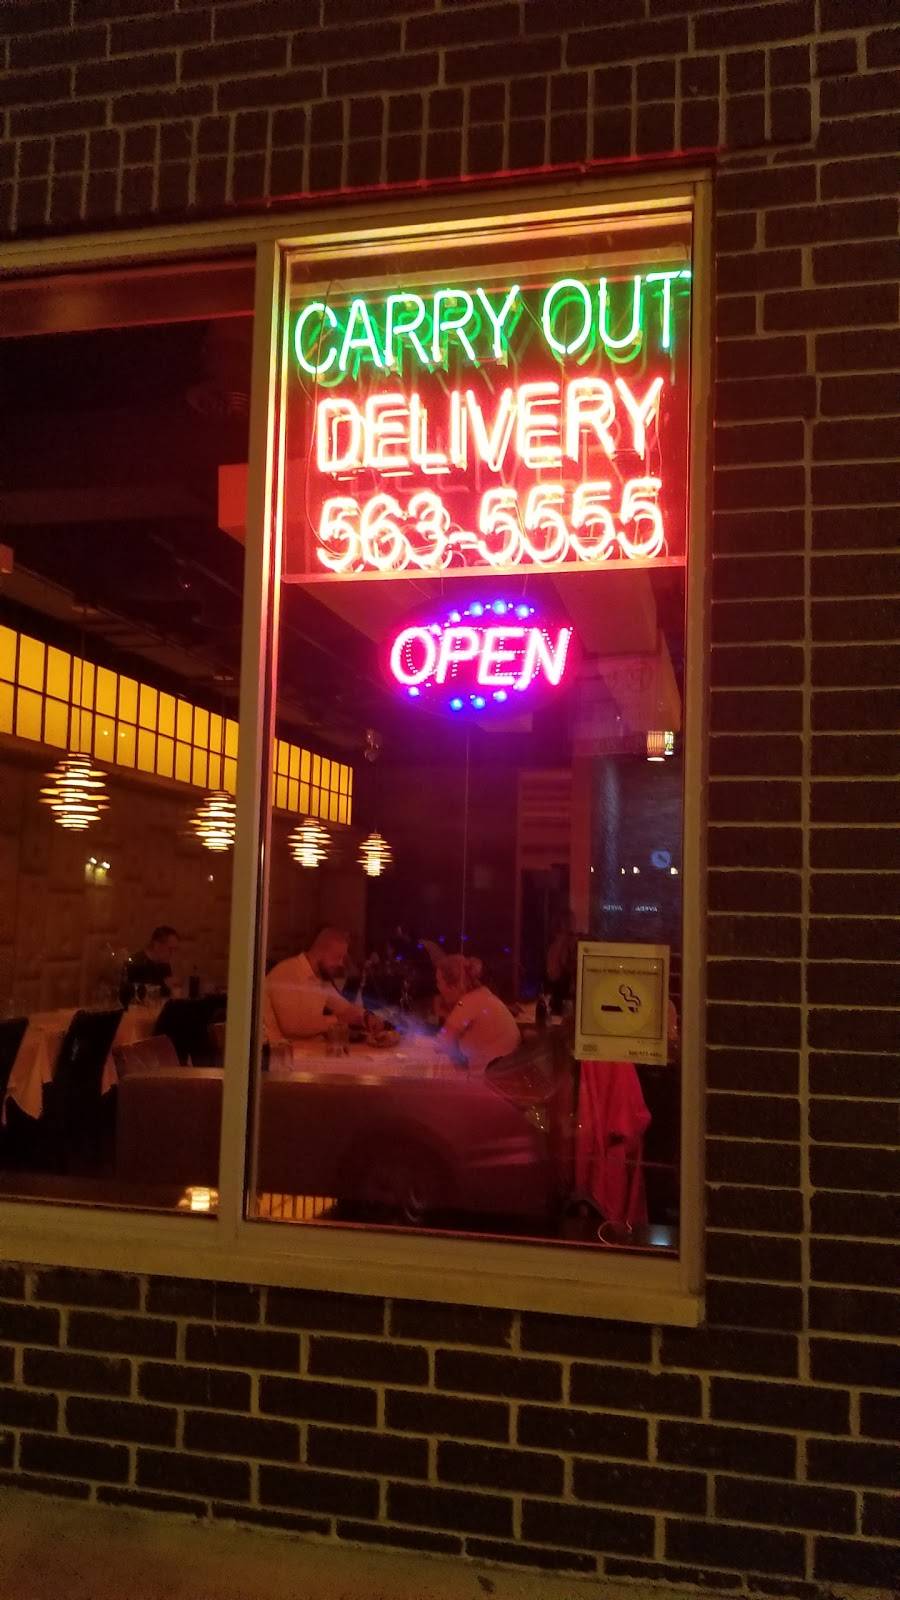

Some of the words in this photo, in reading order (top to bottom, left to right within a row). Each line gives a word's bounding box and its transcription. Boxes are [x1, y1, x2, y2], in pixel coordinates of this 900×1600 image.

[294, 284, 520, 375] CARRY
[541, 269, 692, 355] OUT
[316, 376, 664, 475] DELIVERY
[316, 476, 665, 573] 563-5555
[389, 626, 572, 691] OPEN
